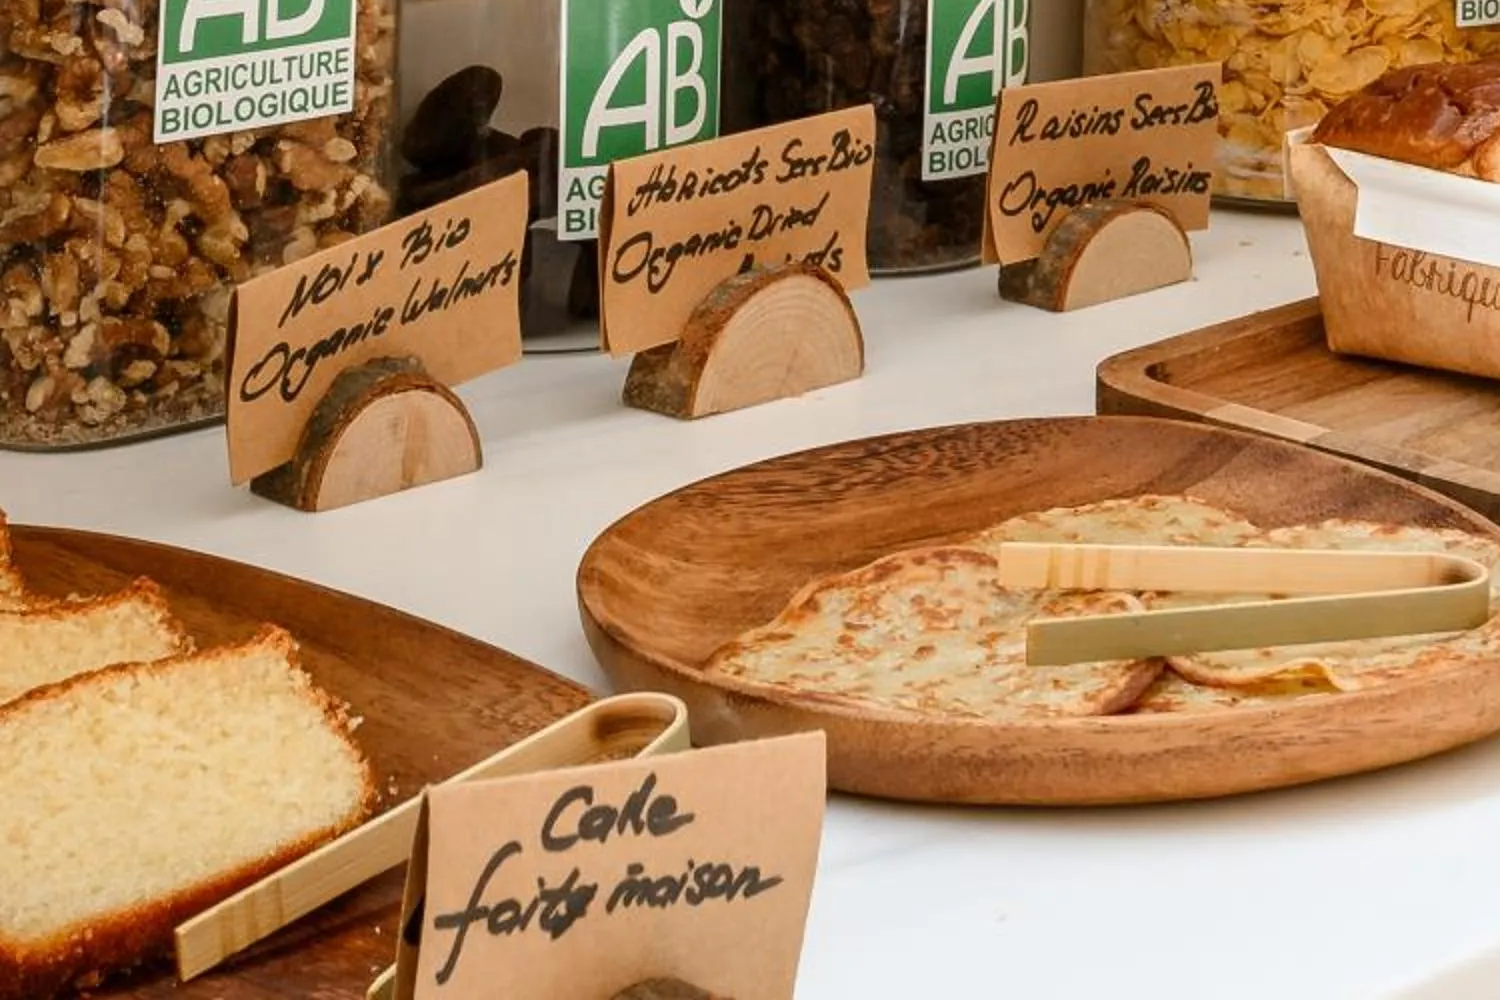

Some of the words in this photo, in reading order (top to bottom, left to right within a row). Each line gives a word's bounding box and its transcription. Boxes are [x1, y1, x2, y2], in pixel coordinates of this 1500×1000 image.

[163, 47, 350, 101] AGRICULTURE
[581, 20, 708, 158] AB
[161, 80, 349, 135] BIOLOGIQUE
[1009, 98, 1125, 146] Raisins
[826, 128, 873, 172] Bio
[999, 168, 1117, 233] Organic
[400, 217, 471, 269] Bio
[612, 219, 742, 294] Organic
[747, 191, 831, 241] Dried
[239, 307, 395, 402] Organic
[541, 771, 695, 853] Cake
[606, 857, 784, 916] maison
